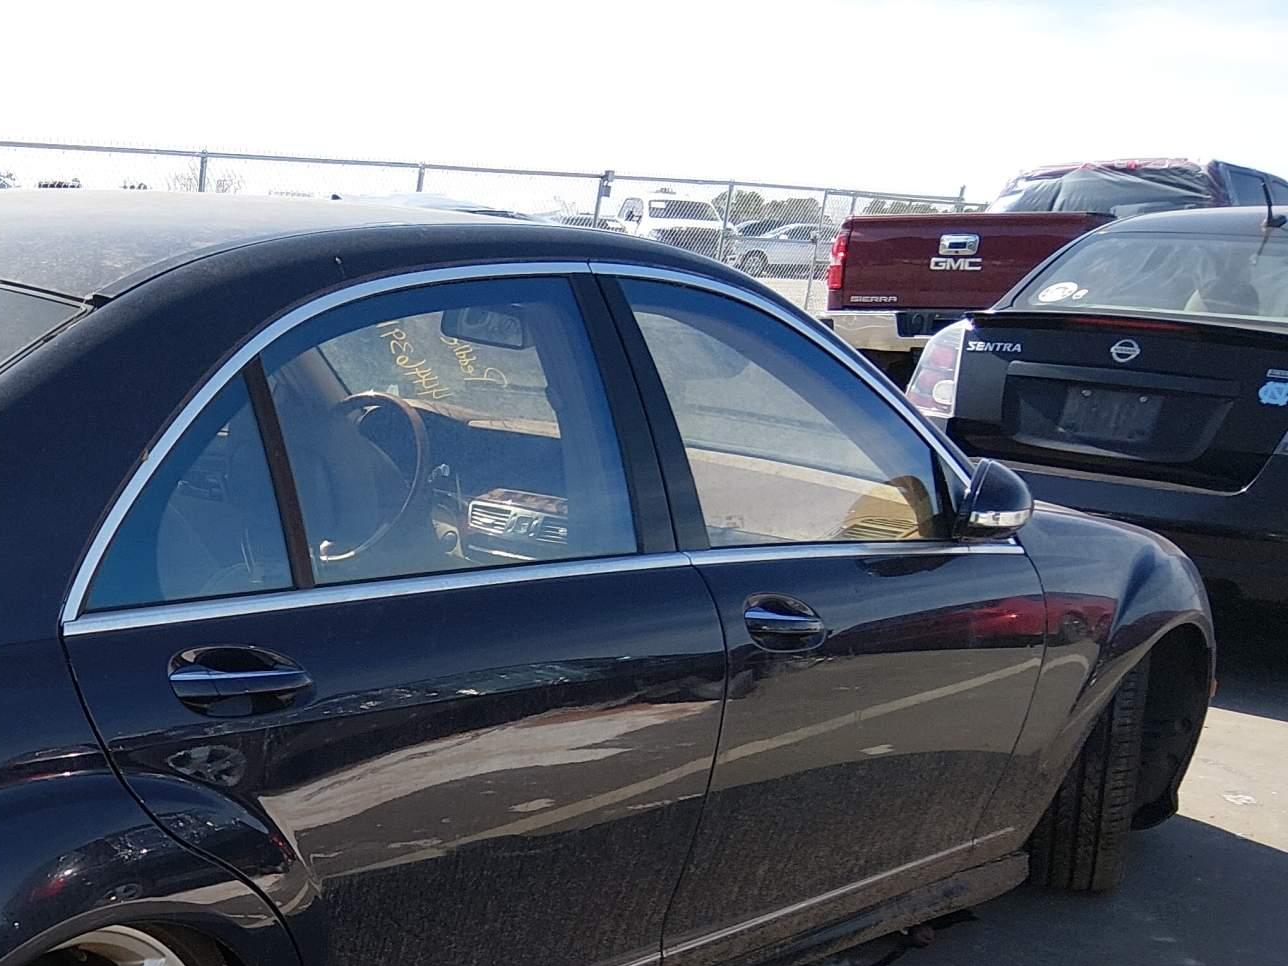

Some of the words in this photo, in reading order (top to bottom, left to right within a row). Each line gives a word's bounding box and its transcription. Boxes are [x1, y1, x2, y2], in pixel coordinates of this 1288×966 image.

[929, 256, 982, 271] GMC
[850, 295, 898, 303] SIERRA
[966, 341, 1022, 353] SENTRA
